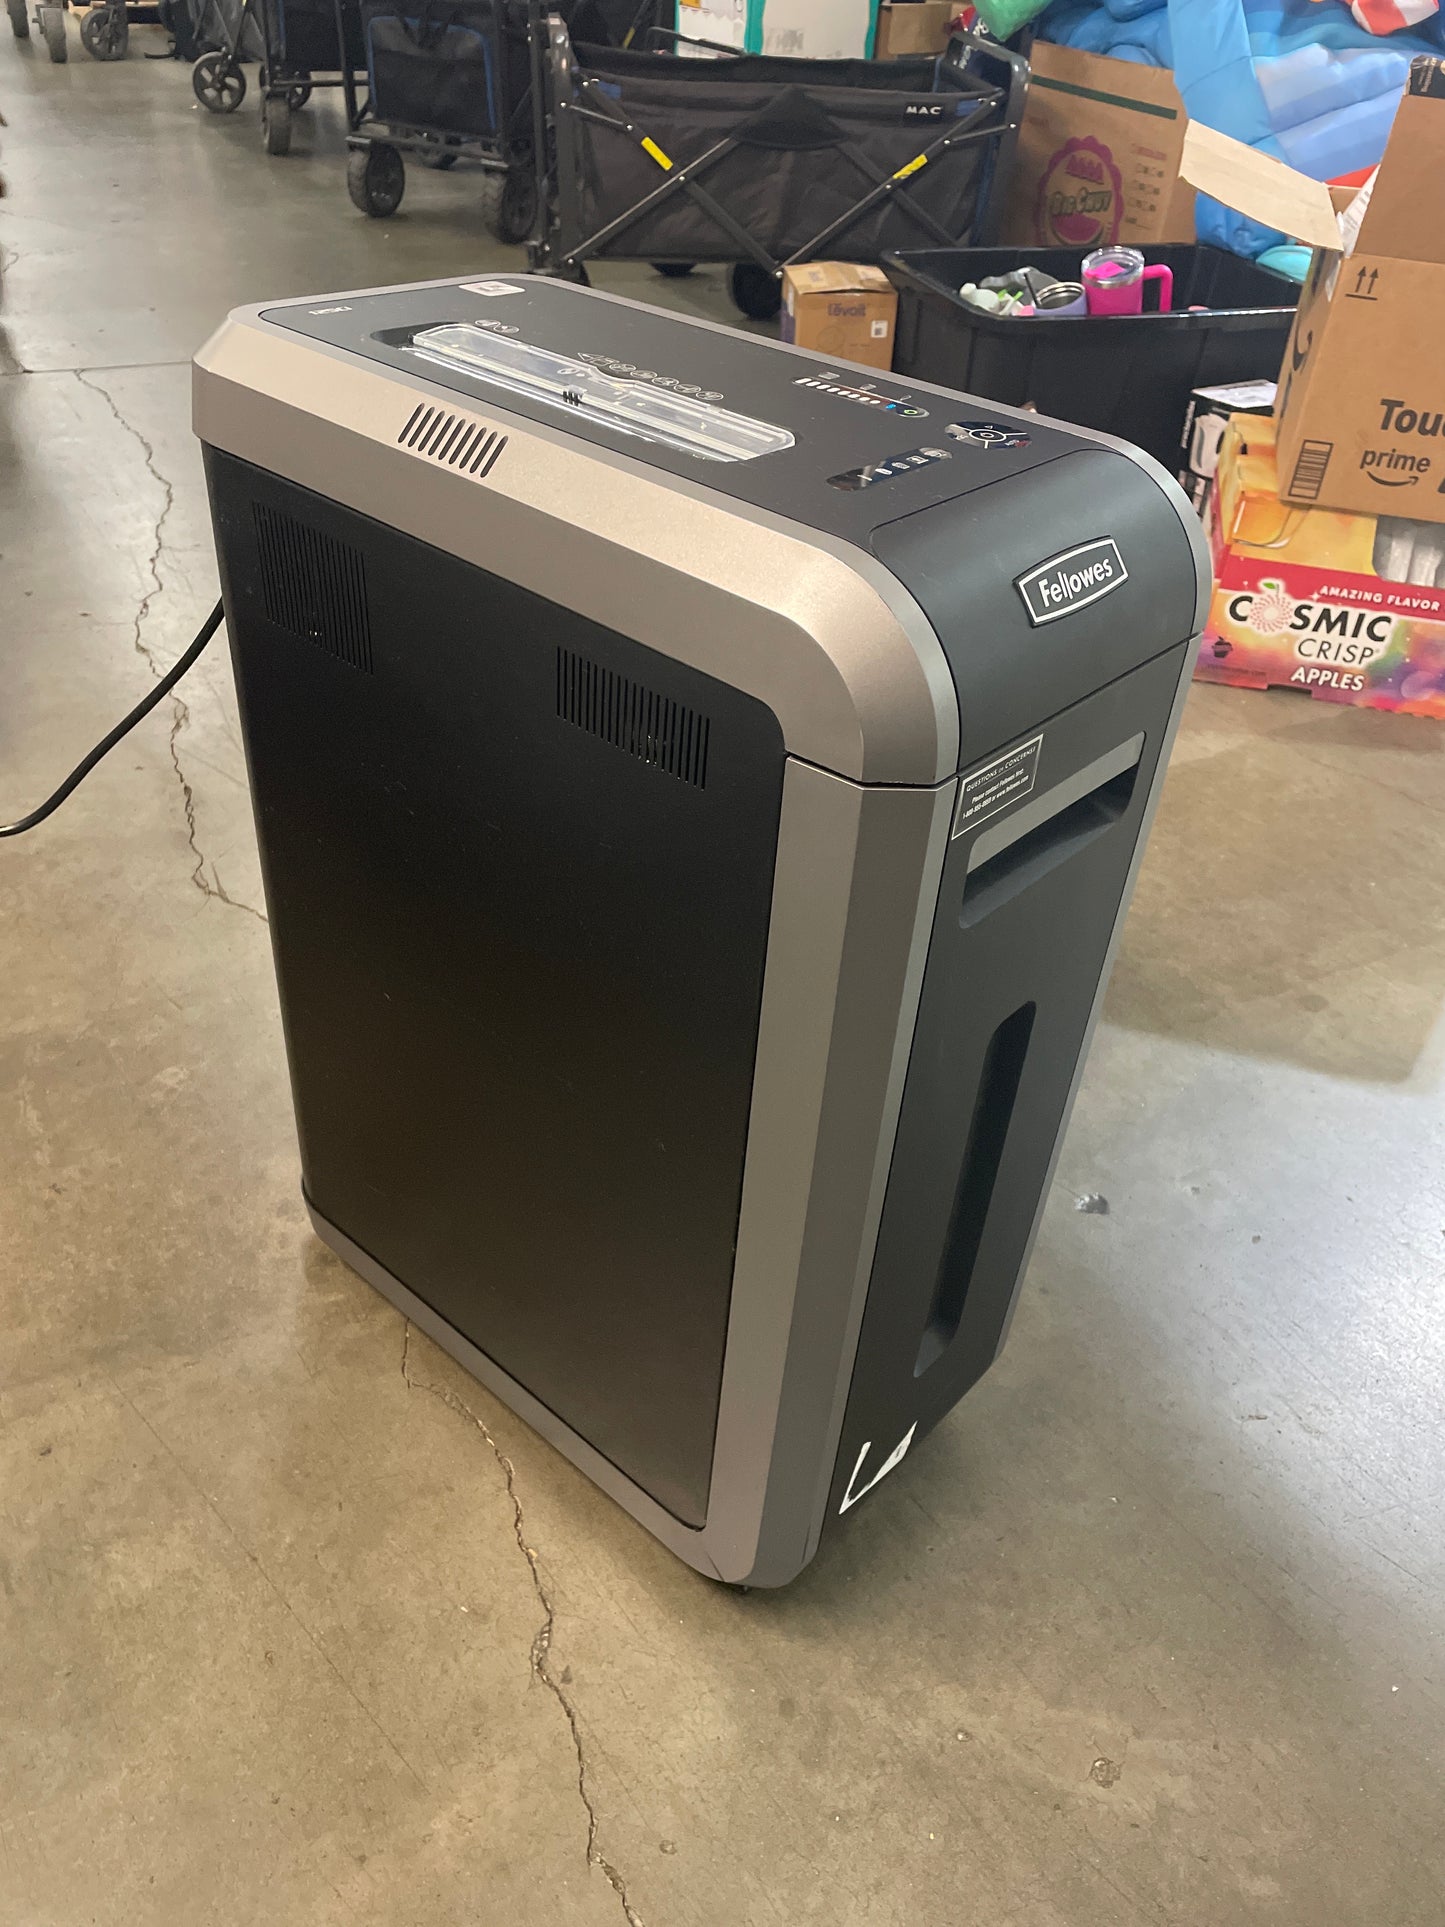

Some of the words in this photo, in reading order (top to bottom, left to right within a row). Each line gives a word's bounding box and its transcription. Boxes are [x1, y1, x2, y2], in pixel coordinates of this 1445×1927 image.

[905, 105, 943, 115] MAC
[1379, 398, 1445, 438] Tou
[1359, 448, 1431, 473] prime
[1038, 558, 1113, 608] Fellowes
[1319, 585, 1383, 604] AMAZING
[1387, 594, 1441, 612] FLAVOR
[1228, 594, 1392, 643] COSMIC
[1297, 638, 1376, 666] CRISP
[1290, 666, 1366, 692] APPLES
